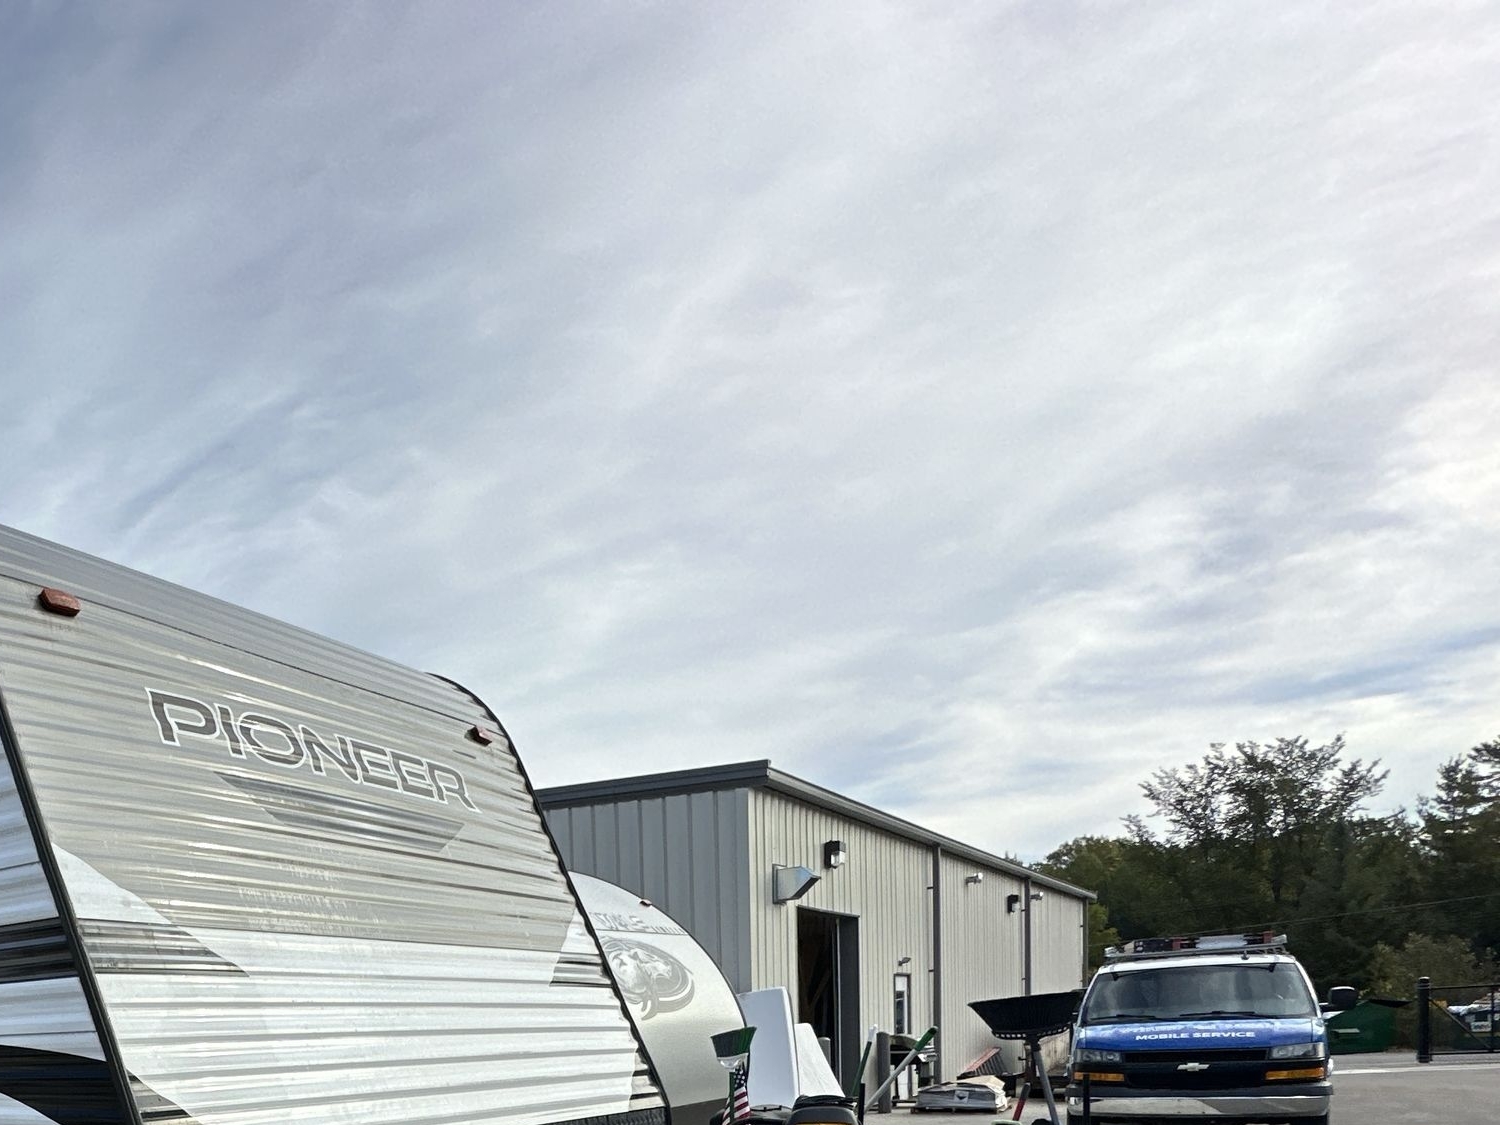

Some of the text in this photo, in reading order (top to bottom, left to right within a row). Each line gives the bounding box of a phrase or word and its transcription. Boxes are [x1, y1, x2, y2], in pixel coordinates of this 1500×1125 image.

[145, 687, 482, 813] PIONEER
[1135, 1031, 1256, 1041] MOBILE SERVICE
